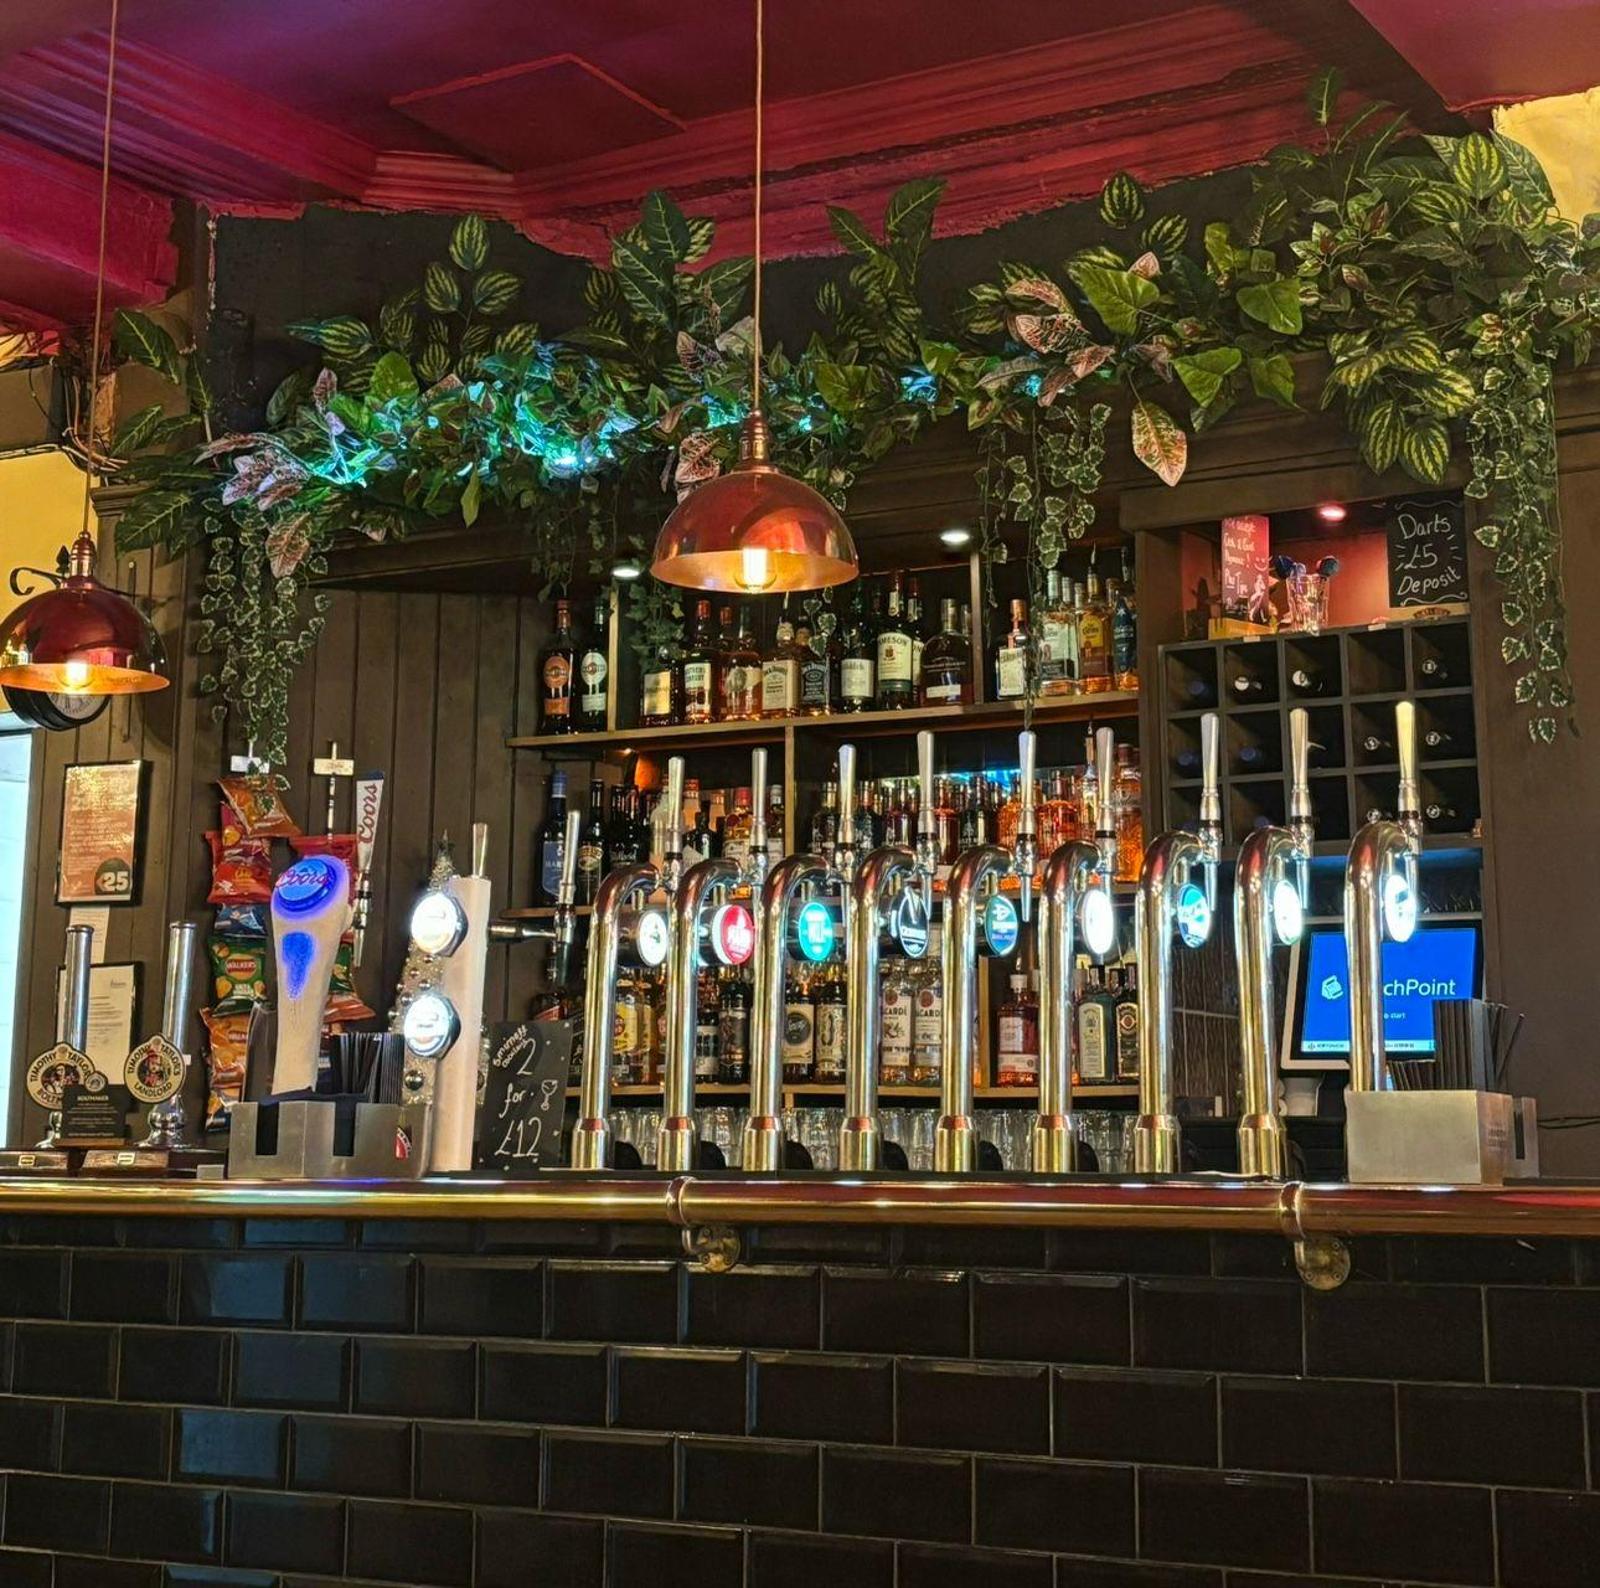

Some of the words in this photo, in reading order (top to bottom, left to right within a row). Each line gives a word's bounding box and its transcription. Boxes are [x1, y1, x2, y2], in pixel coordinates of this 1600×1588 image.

[1397, 513, 1452, 539] Darts
[1403, 543, 1438, 570] £5
[1397, 566, 1462, 596] Deposit
[878, 636, 908, 646] AMESON
[357, 784, 377, 844] Coors
[101, 870, 129, 892] 25
[275, 867, 331, 889] Coors
[1384, 978, 1457, 997] chPoint
[30, 1052, 57, 1082] TIMOTHY
[516, 1037, 537, 1075] 2
[498, 1082, 527, 1119] for
[494, 1116, 542, 1158] £12
